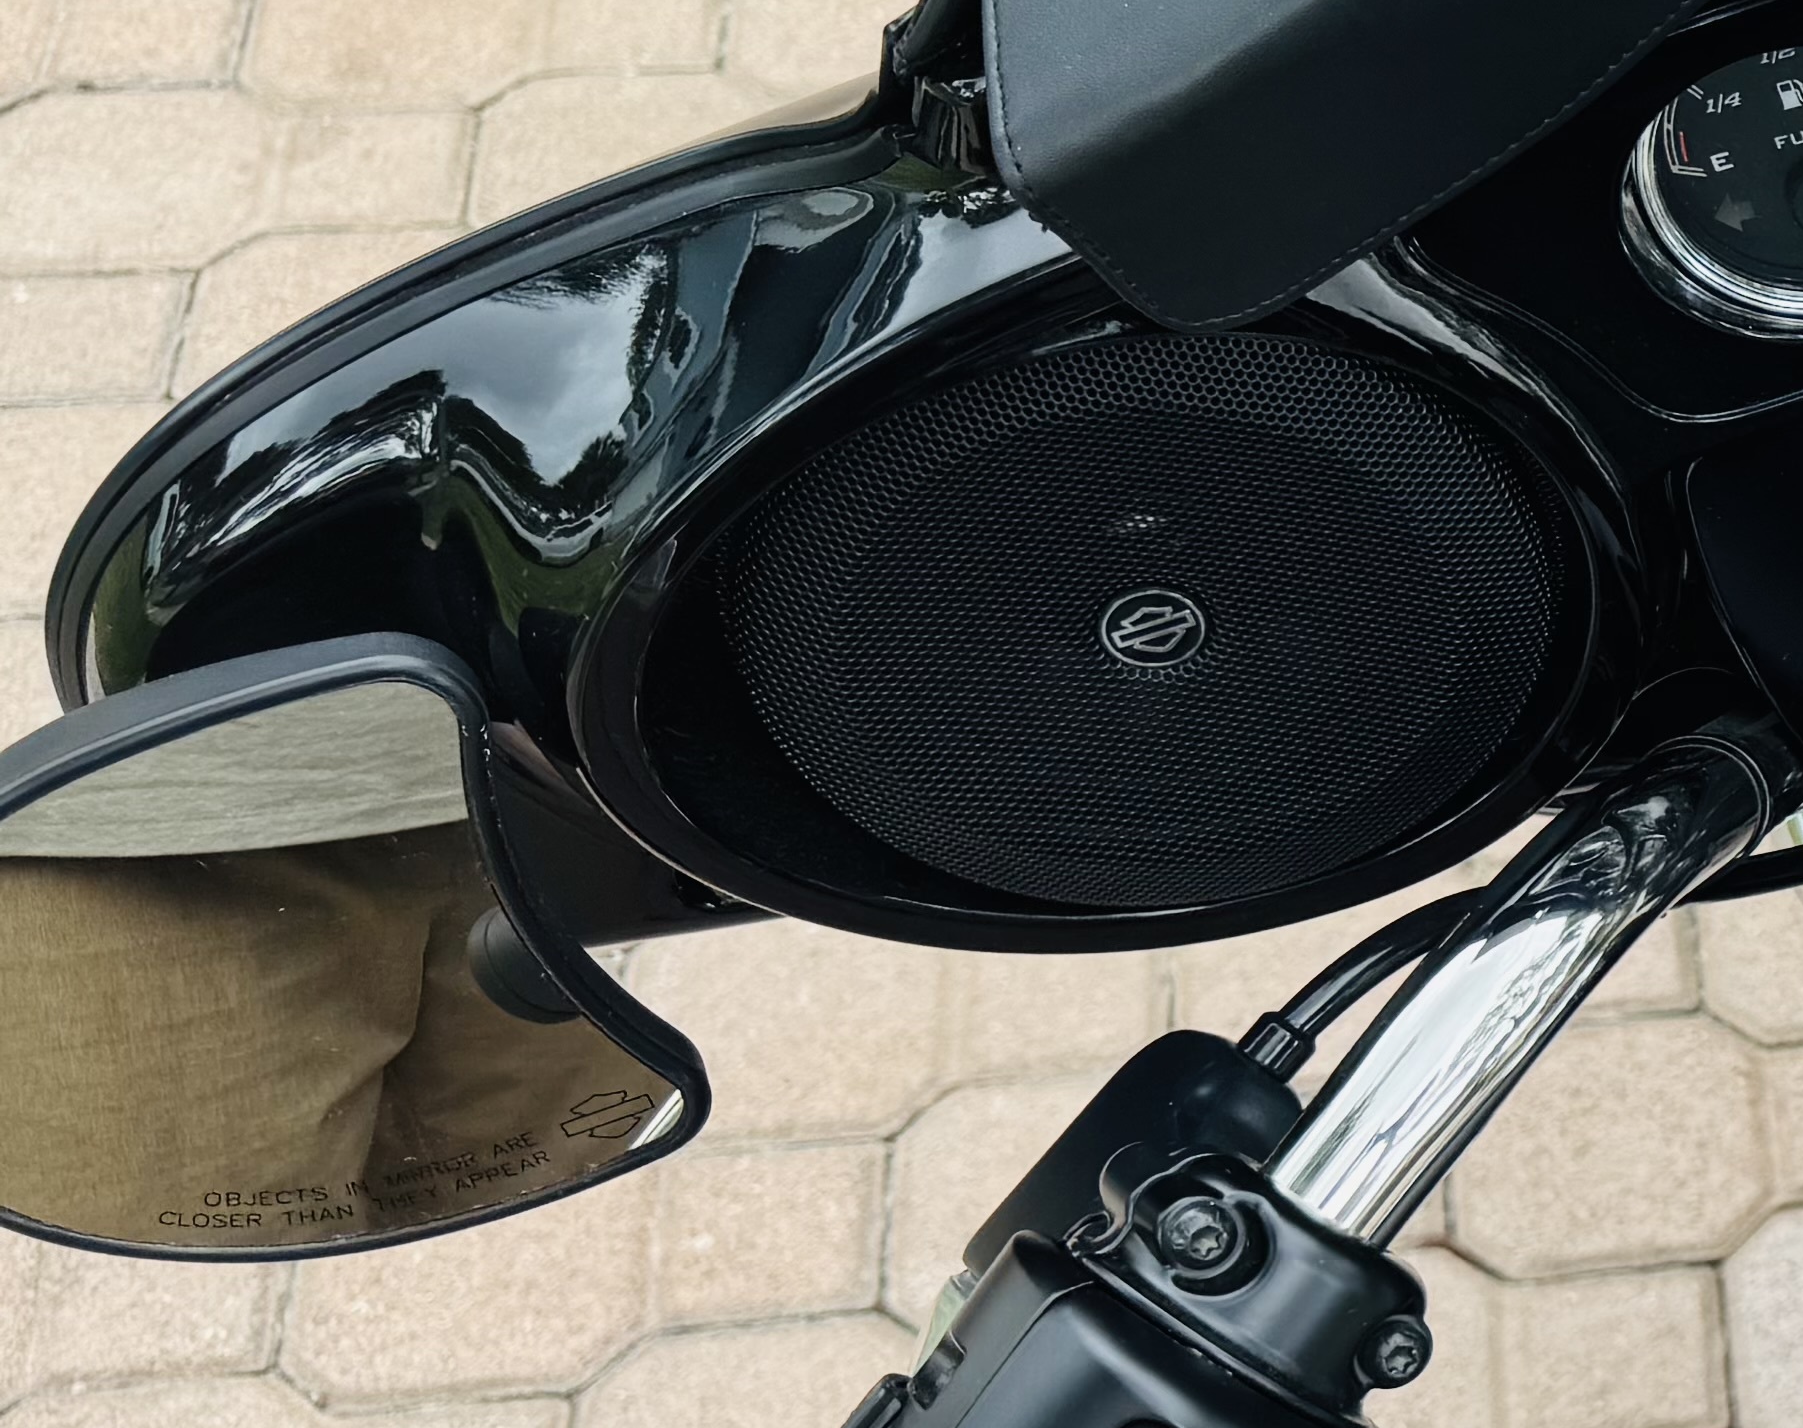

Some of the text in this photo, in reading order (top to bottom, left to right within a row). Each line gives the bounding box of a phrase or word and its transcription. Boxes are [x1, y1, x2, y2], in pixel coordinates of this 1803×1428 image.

[1705, 91, 1742, 114] 1/4
[1710, 151, 1735, 172] E
[158, 1210, 263, 1230] CLOSER
[281, 1204, 354, 1227] THAN
[455, 1149, 550, 1193] APPEAR
[204, 1131, 538, 1209] OBJECTS IN MIRROR ARE
